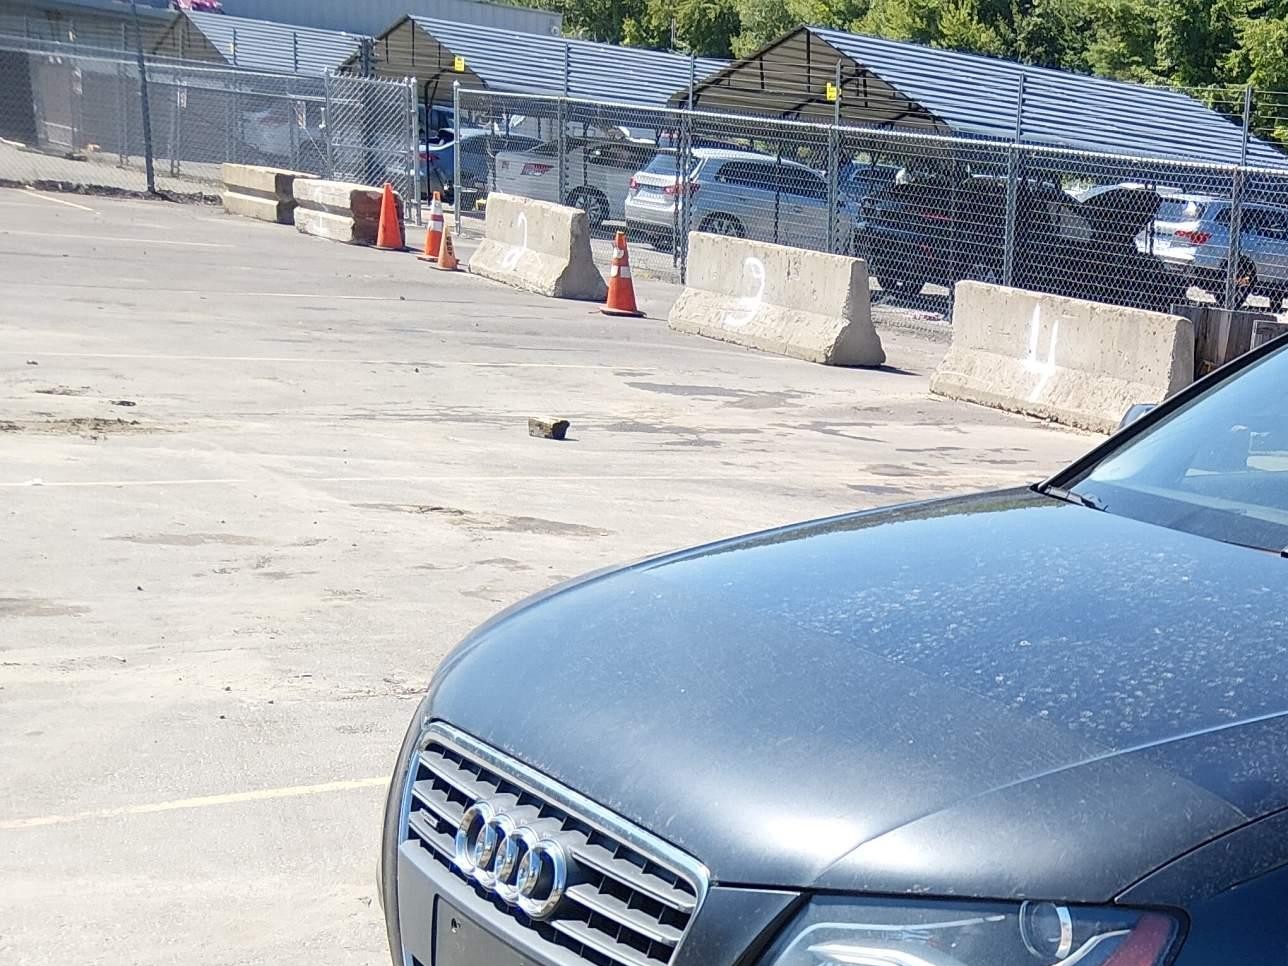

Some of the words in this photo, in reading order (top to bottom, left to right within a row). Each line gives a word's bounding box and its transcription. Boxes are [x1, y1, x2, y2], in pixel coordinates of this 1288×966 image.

[499, 211, 528, 271] 2
[720, 257, 767, 328] 3
[1019, 302, 1060, 402] 4
